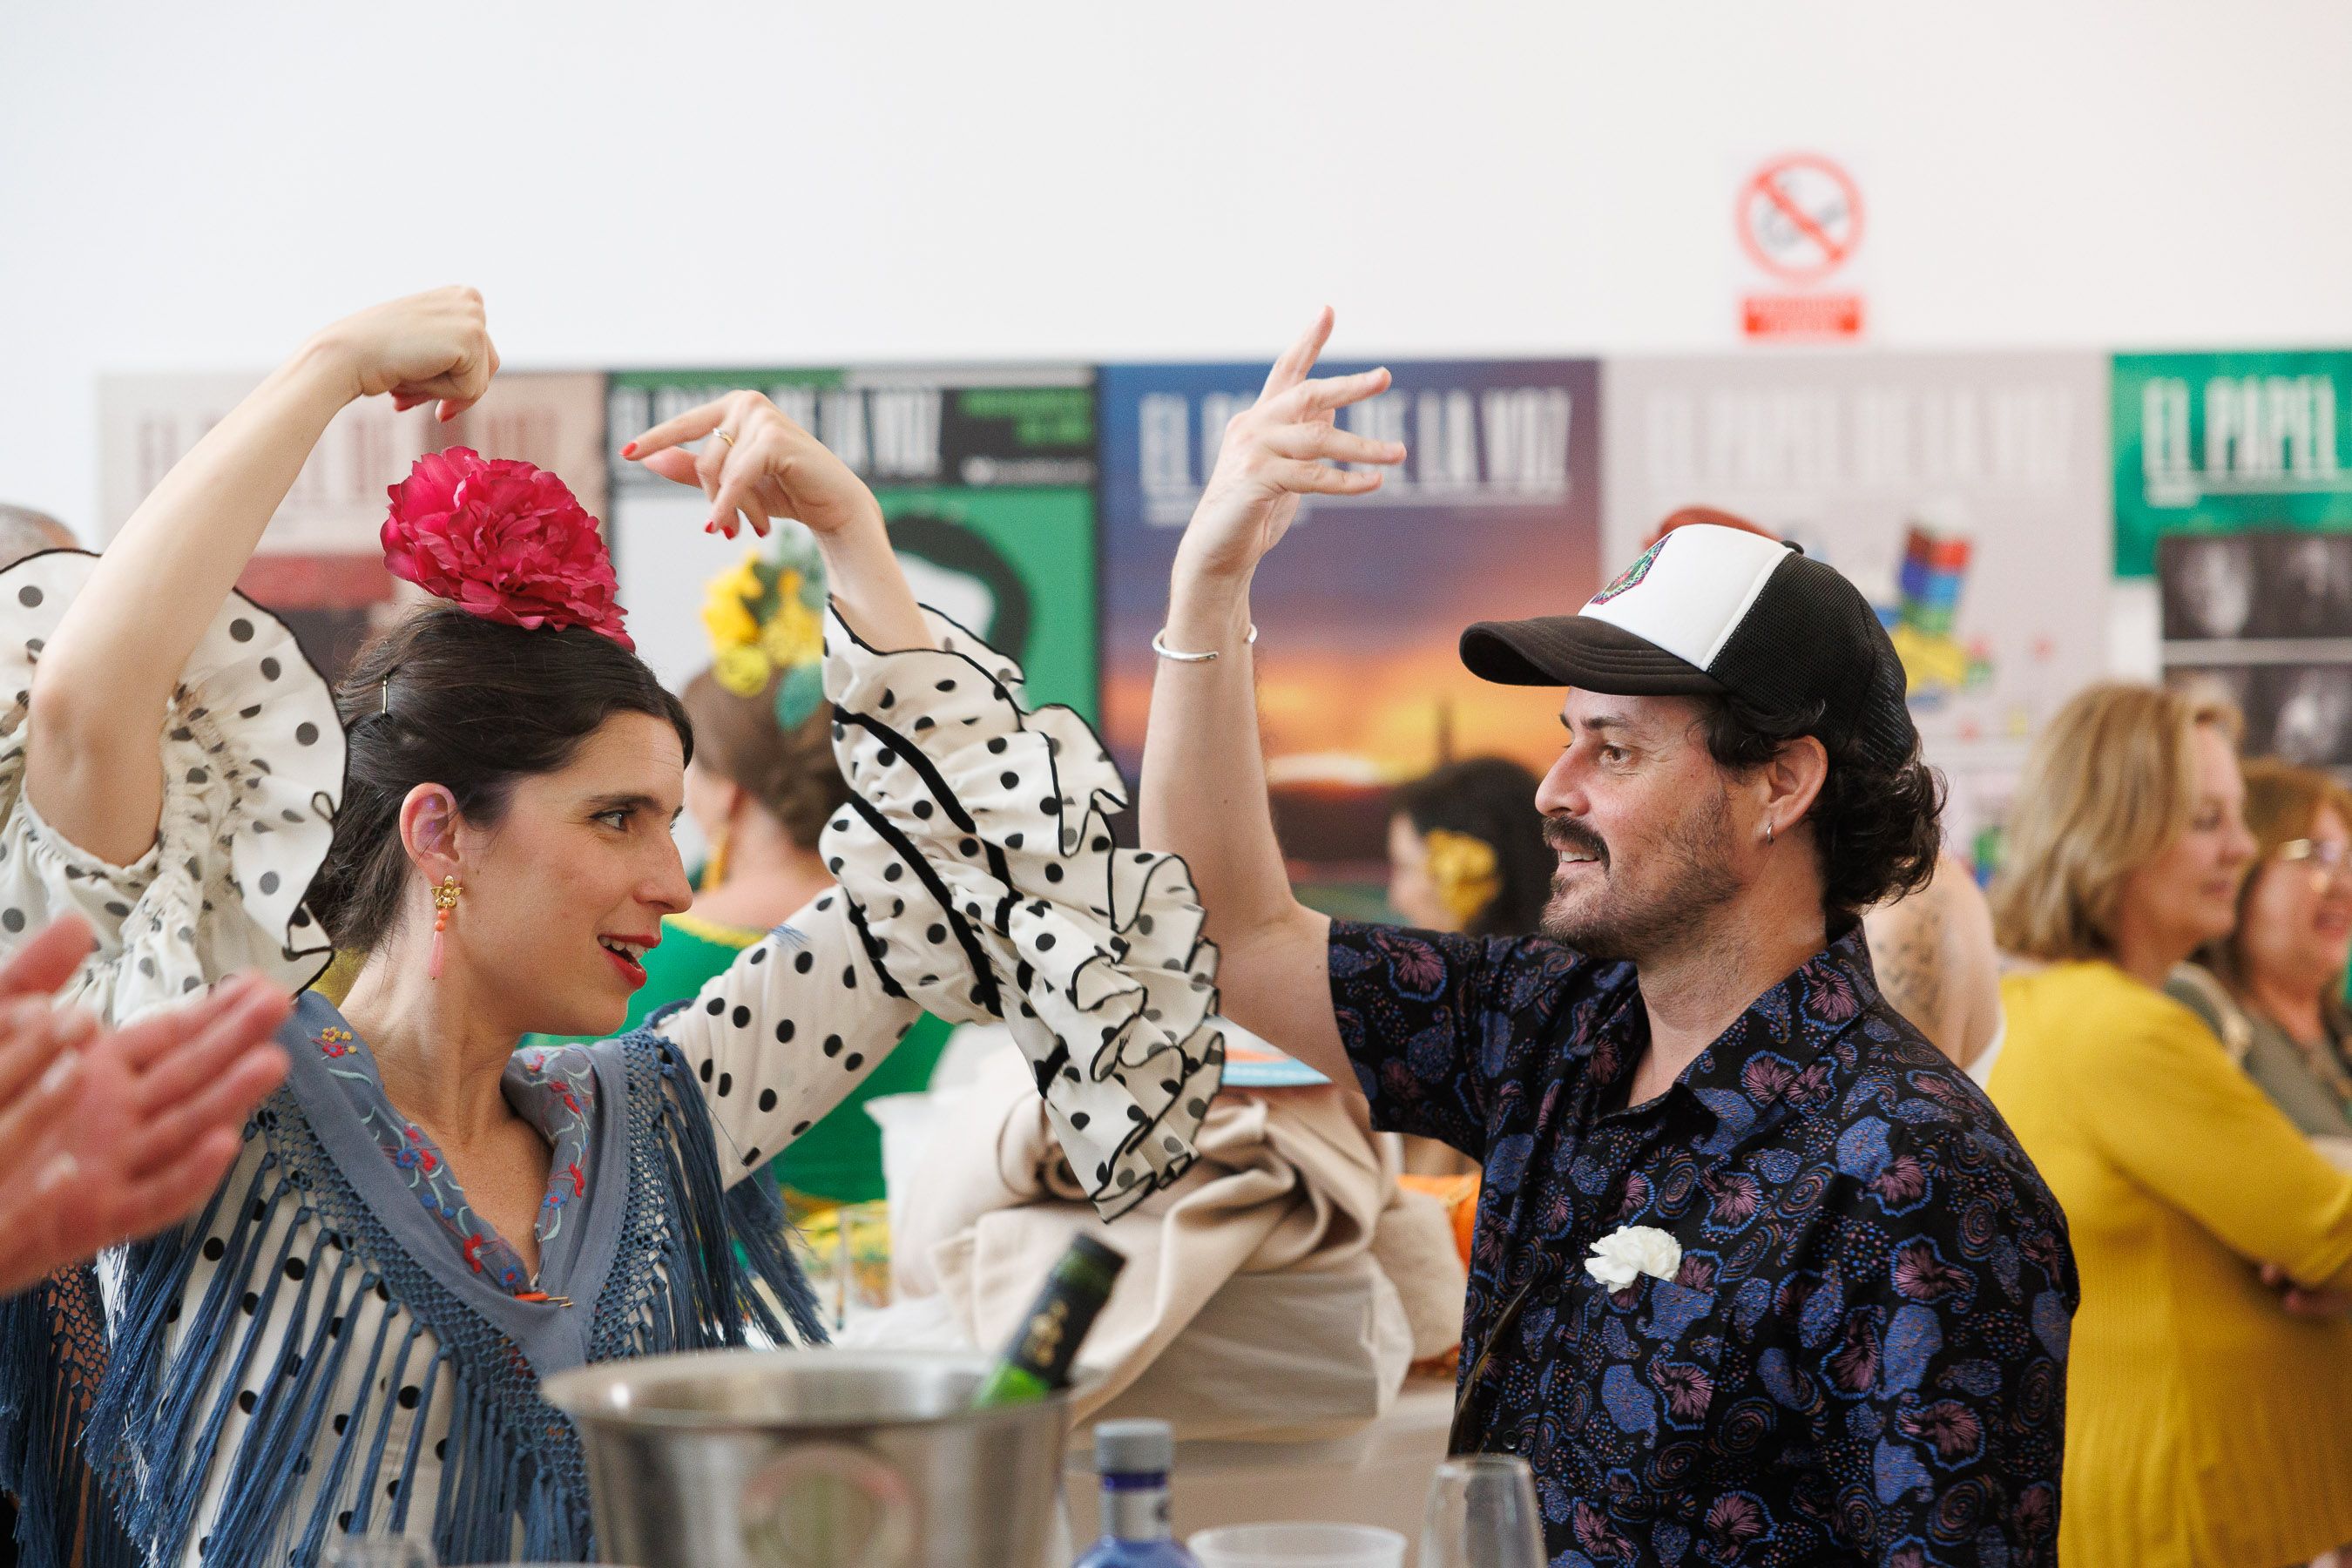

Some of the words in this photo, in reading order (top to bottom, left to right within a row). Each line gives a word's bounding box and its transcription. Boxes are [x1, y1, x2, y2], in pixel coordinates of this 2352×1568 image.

[874, 389, 944, 479] VOZ
[1139, 393, 1190, 493] EL
[1416, 389, 1479, 489] LA
[1483, 386, 1571, 489] VOZ
[2141, 375, 2192, 481] EL
[2205, 373, 2336, 479] PAPEL
